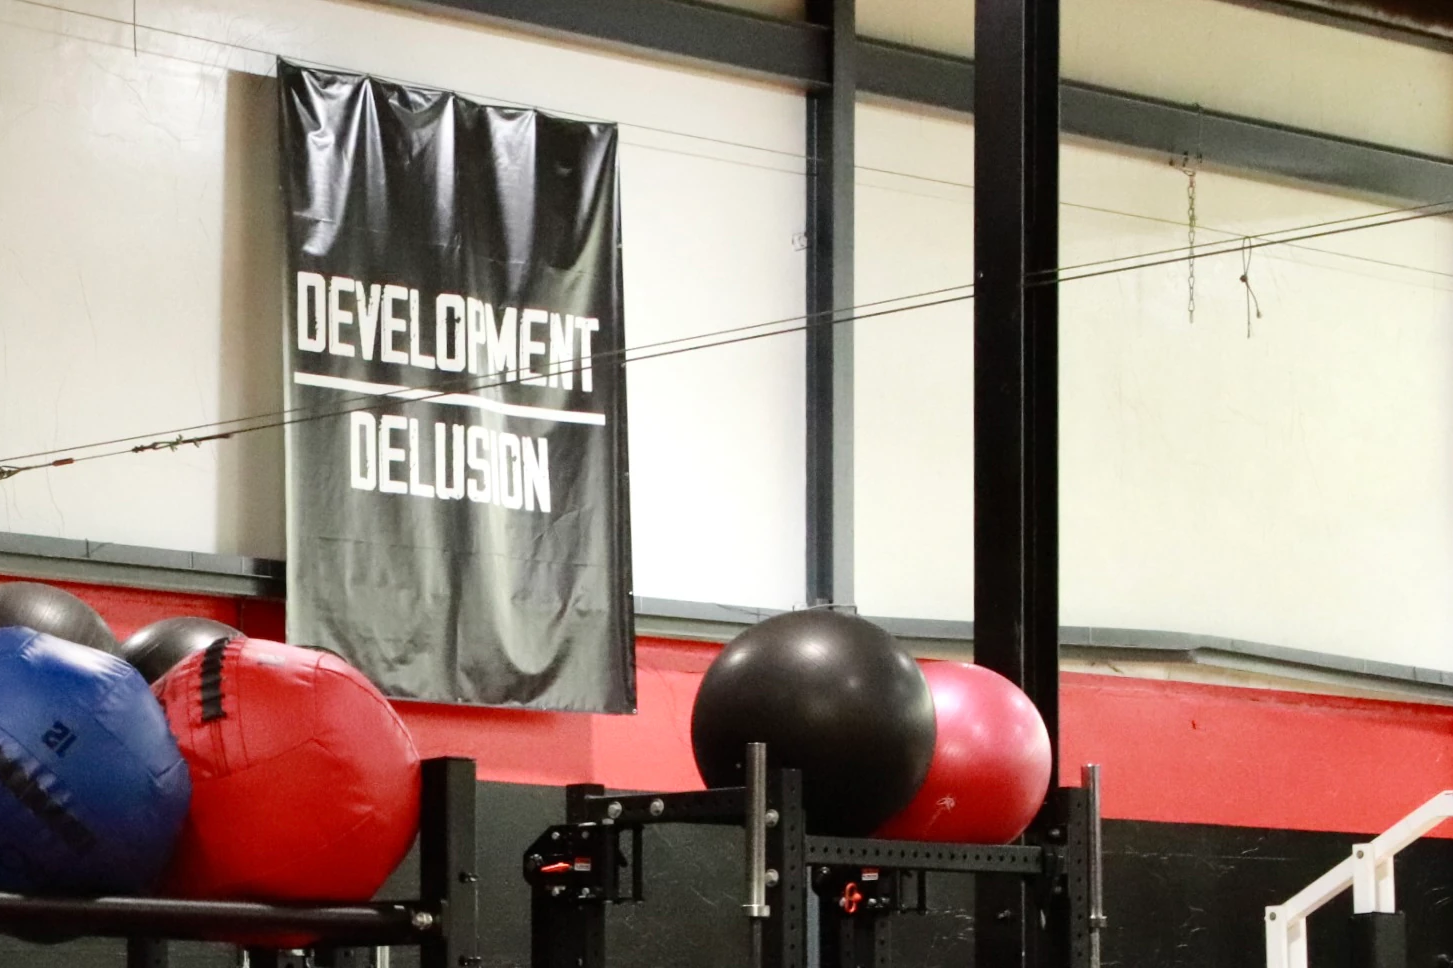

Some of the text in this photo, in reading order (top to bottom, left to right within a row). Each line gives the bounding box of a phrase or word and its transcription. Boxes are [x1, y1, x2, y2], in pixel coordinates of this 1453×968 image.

[297, 271, 599, 392] DEVELOPMENT
[350, 411, 552, 513] DELUSION
[42, 720, 78, 759] 12
